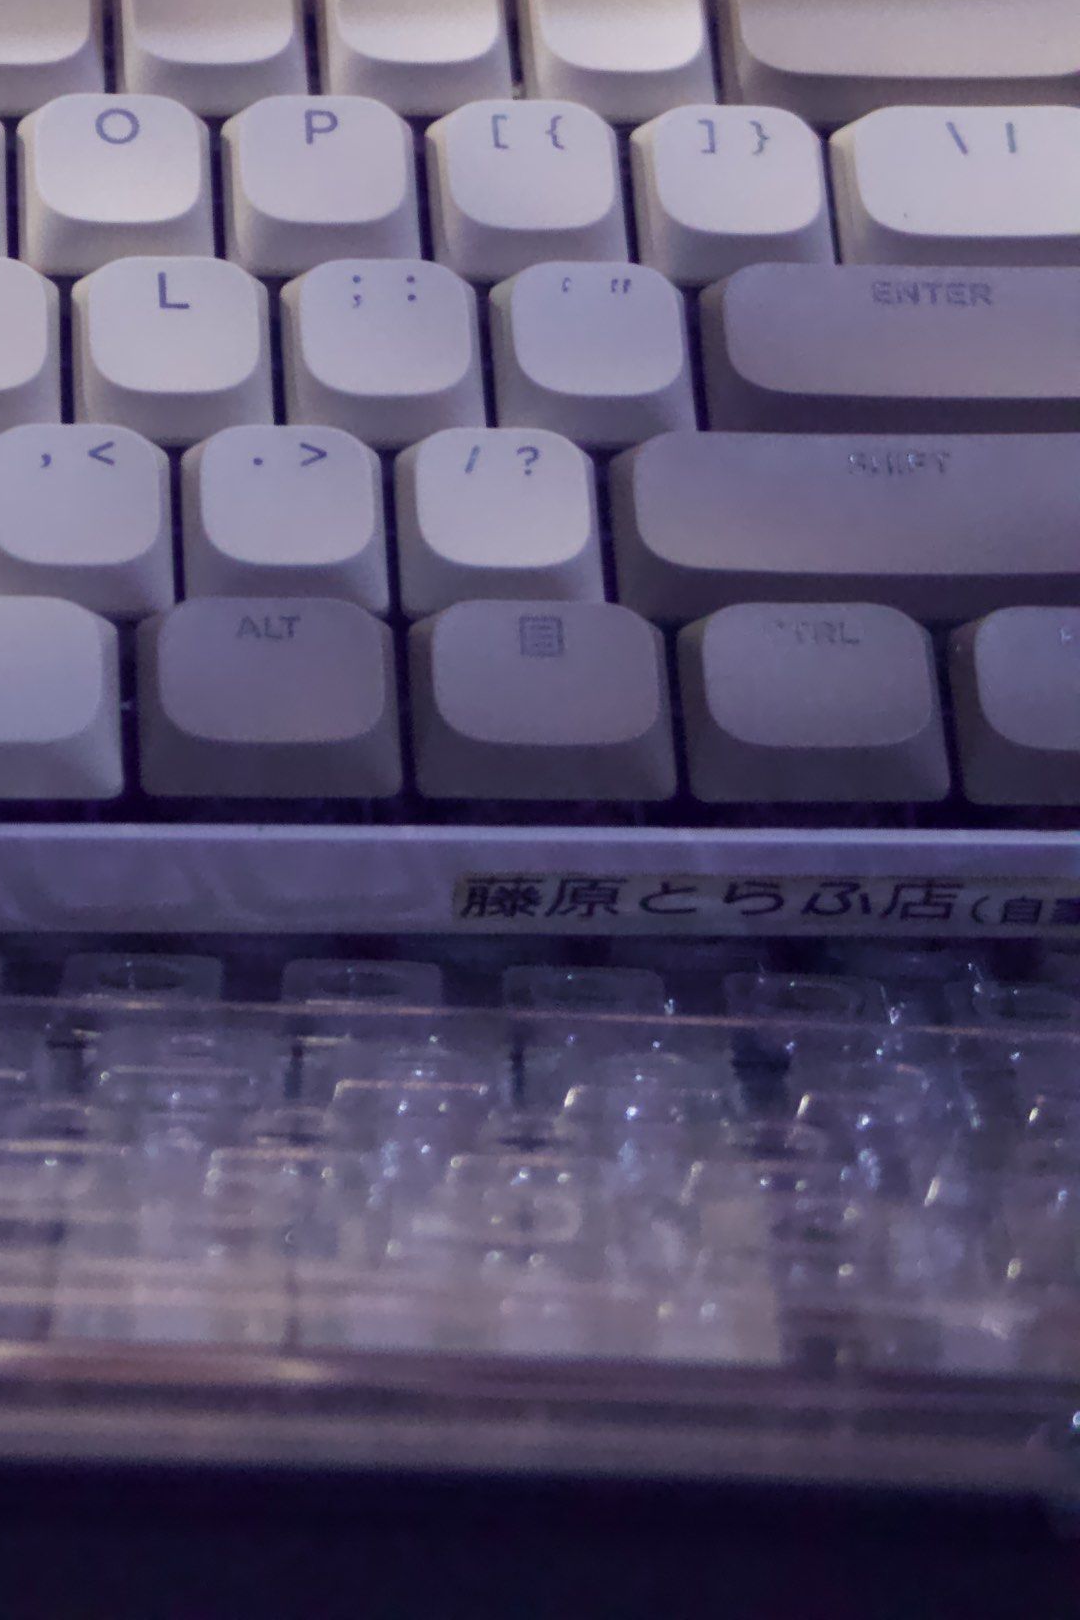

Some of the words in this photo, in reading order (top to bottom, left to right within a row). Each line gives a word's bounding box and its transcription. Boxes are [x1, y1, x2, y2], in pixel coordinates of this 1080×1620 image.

[94, 107, 141, 145] O
[303, 108, 339, 145] P
[157, 271, 191, 310] L
[870, 280, 994, 308] ENTER
[235, 614, 302, 643] ALT
